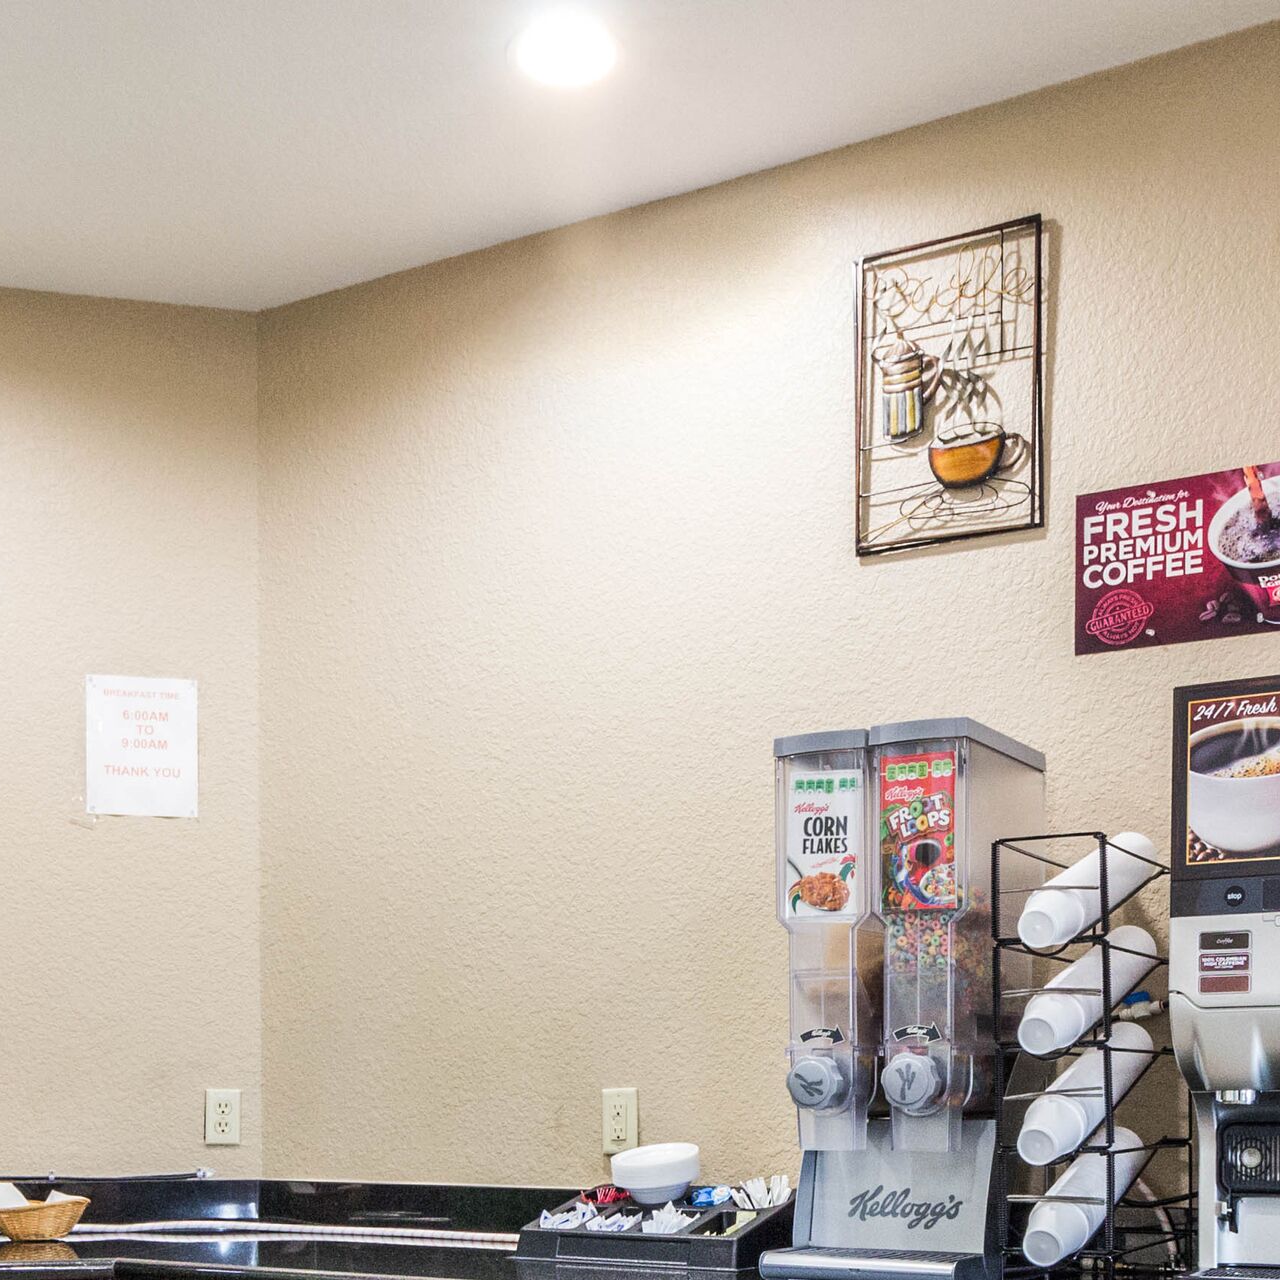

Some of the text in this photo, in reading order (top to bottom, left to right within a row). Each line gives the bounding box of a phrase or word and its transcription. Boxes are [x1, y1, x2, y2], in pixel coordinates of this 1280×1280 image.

[1095, 489, 1190, 515] Your Destination for
[1083, 498, 1204, 545] FRESH
[1083, 528, 1203, 566] PREMIUM
[1082, 550, 1204, 589] COFFEE
[1090, 605, 1150, 632] GUARANTEED
[103, 688, 158, 699] BREAKFAST
[122, 709, 169, 722] 6:00AM
[1193, 700, 1233, 721] 24/7
[1236, 699, 1277, 717] Fresh
[136, 724, 154, 736] TO
[121, 737, 169, 750] 9:00AM
[104, 765, 181, 778] THANK YOU
[885, 786, 924, 802] Kellogg's
[793, 802, 830, 816] Kellogg's
[888, 792, 946, 831] FROOT
[803, 815, 849, 838] CORN
[899, 809, 951, 838] LOOPS
[802, 837, 848, 855] FLAKES
[1227, 892, 1242, 901] stop
[847, 1184, 963, 1230] Kellogg's
